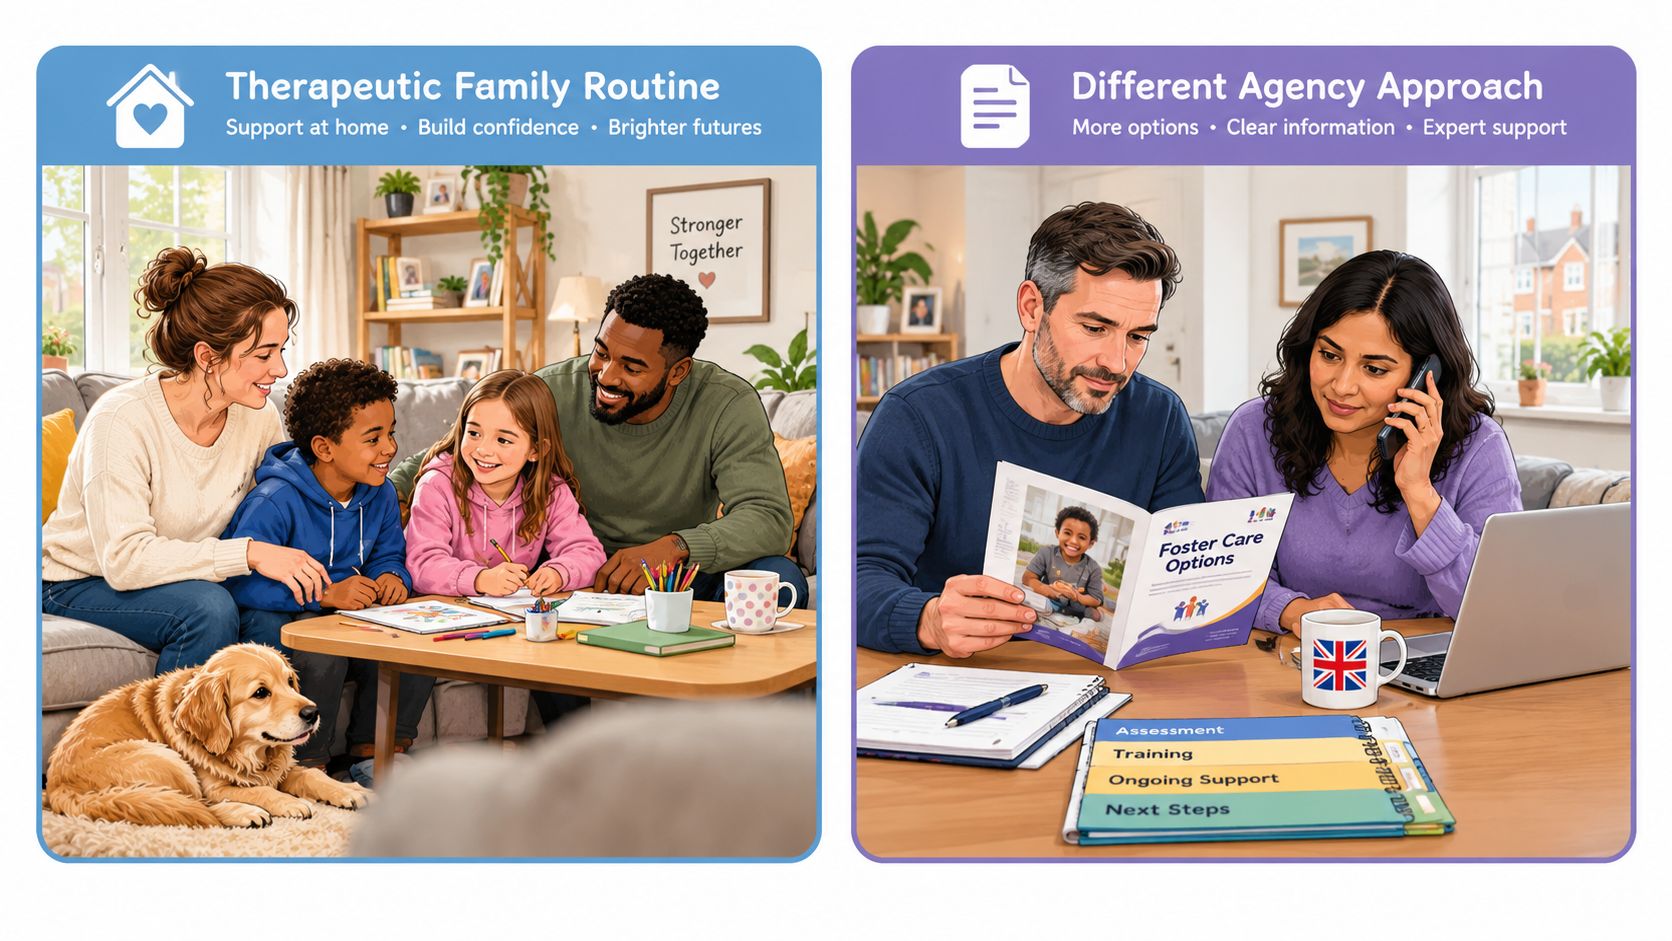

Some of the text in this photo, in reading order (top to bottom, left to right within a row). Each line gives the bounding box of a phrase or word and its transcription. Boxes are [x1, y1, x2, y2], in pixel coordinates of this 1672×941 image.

[670, 216, 743, 237] Stronger
[670, 241, 743, 266] Together
[1159, 532, 1264, 557] Foster Care
[1165, 553, 1235, 574] Options
[1115, 725, 1225, 736] Assessment
[1113, 749, 1193, 761] Training
[1109, 773, 1279, 788] Ongoing Support
[1105, 803, 1230, 818] Next Steps
